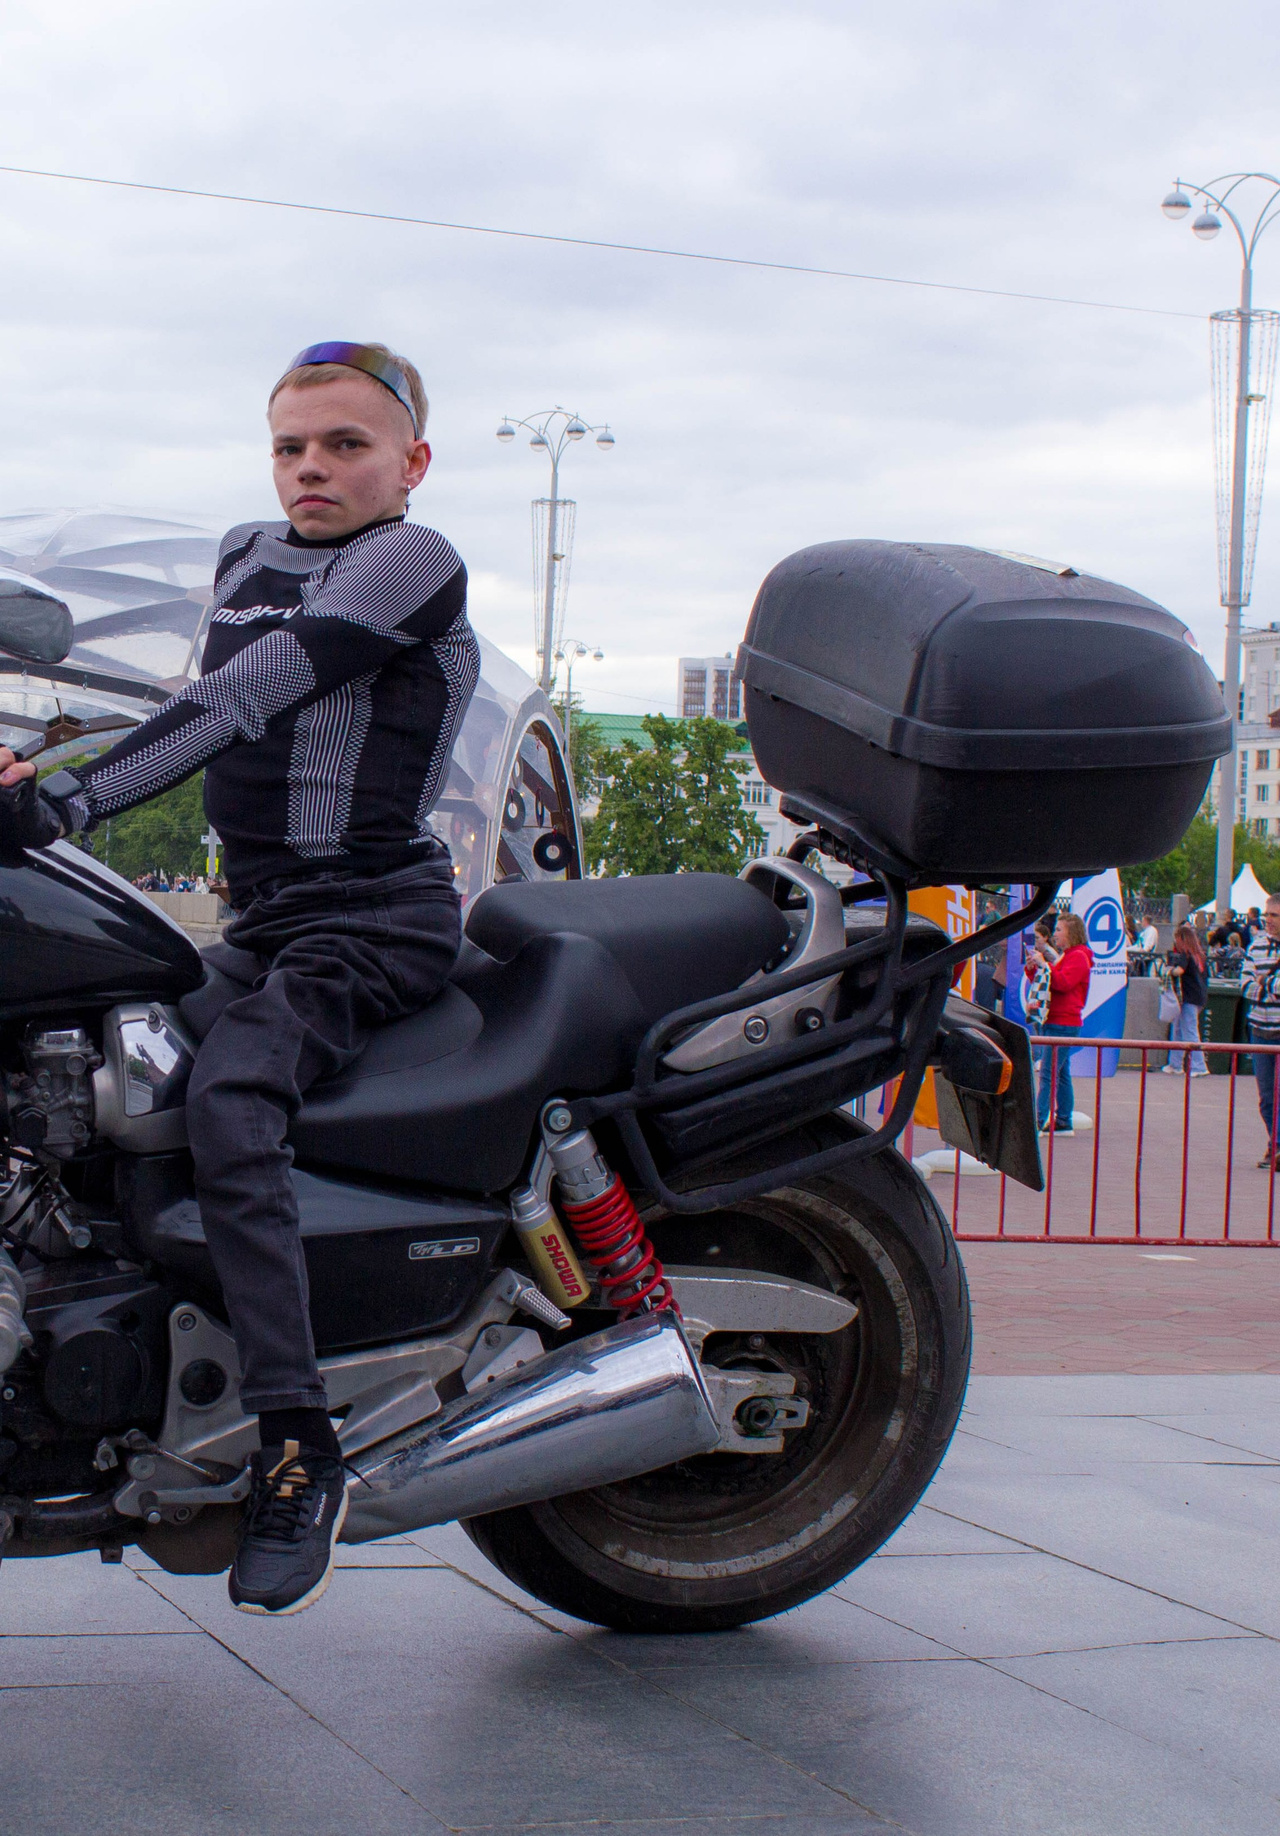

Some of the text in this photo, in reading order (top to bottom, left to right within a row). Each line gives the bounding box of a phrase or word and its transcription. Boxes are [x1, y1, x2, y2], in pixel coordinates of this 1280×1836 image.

[1088, 903, 1122, 951] 4
[431, 1244, 475, 1256] LD
[540, 1233, 582, 1298] SHOWA
[314, 1491, 327, 1526] Reebok
